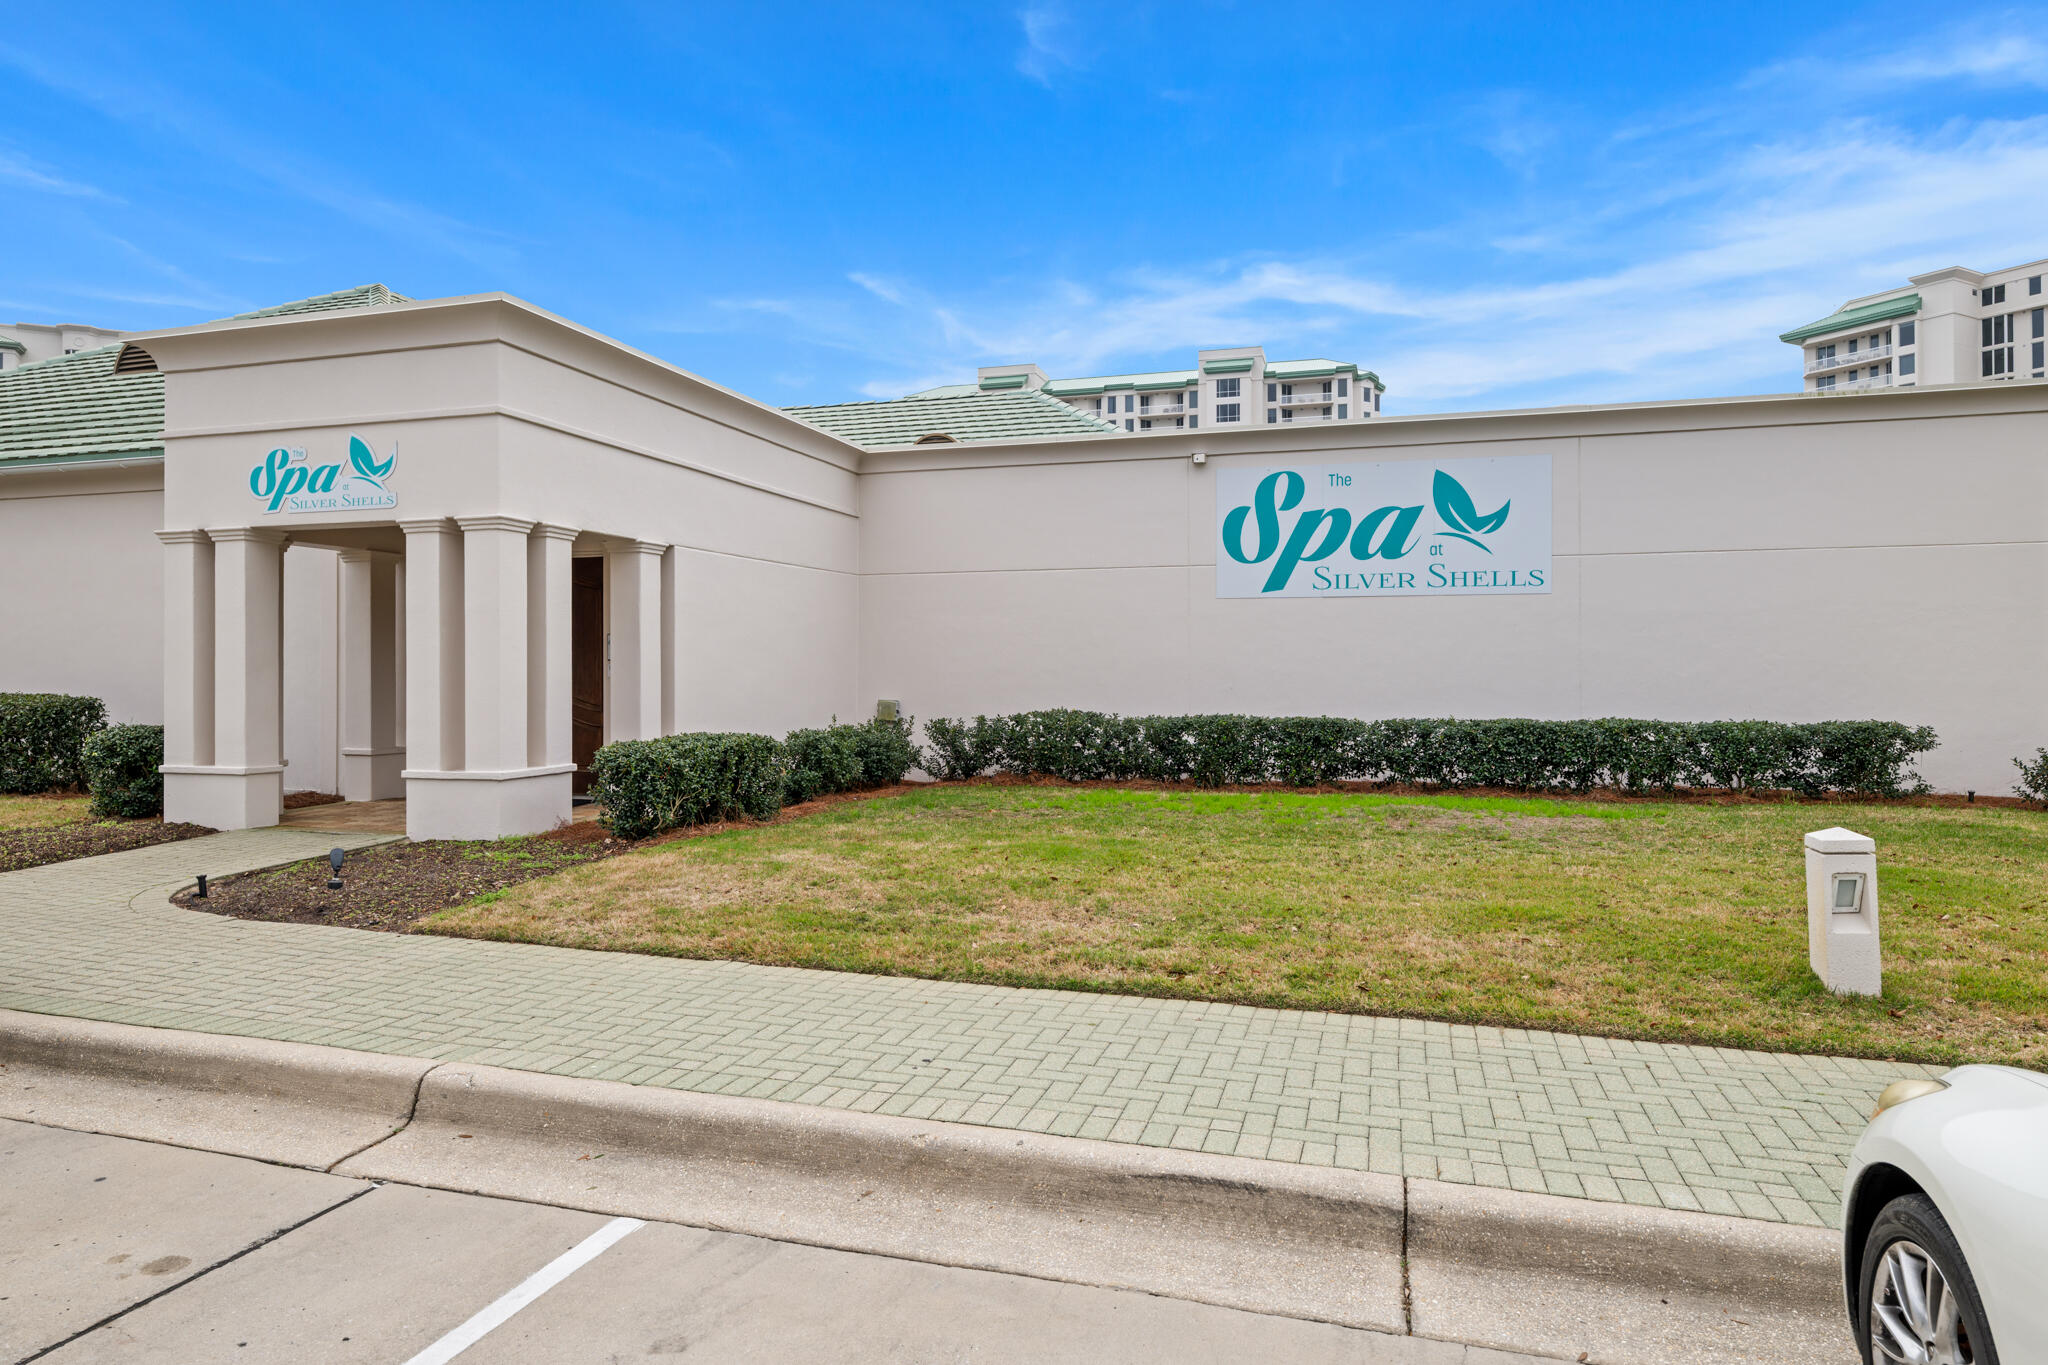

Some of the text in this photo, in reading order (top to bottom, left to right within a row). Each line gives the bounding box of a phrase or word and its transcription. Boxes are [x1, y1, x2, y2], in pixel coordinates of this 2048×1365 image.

[292, 449, 304, 458] The
[250, 449, 341, 511] Spa
[342, 483, 349, 491] at
[1328, 473, 1352, 487] The
[290, 494, 394, 510] SILVER SHELLS
[1222, 470, 1425, 593] Spa
[1429, 544, 1443, 556] at
[1312, 563, 1545, 590] SILVER SHELLS
